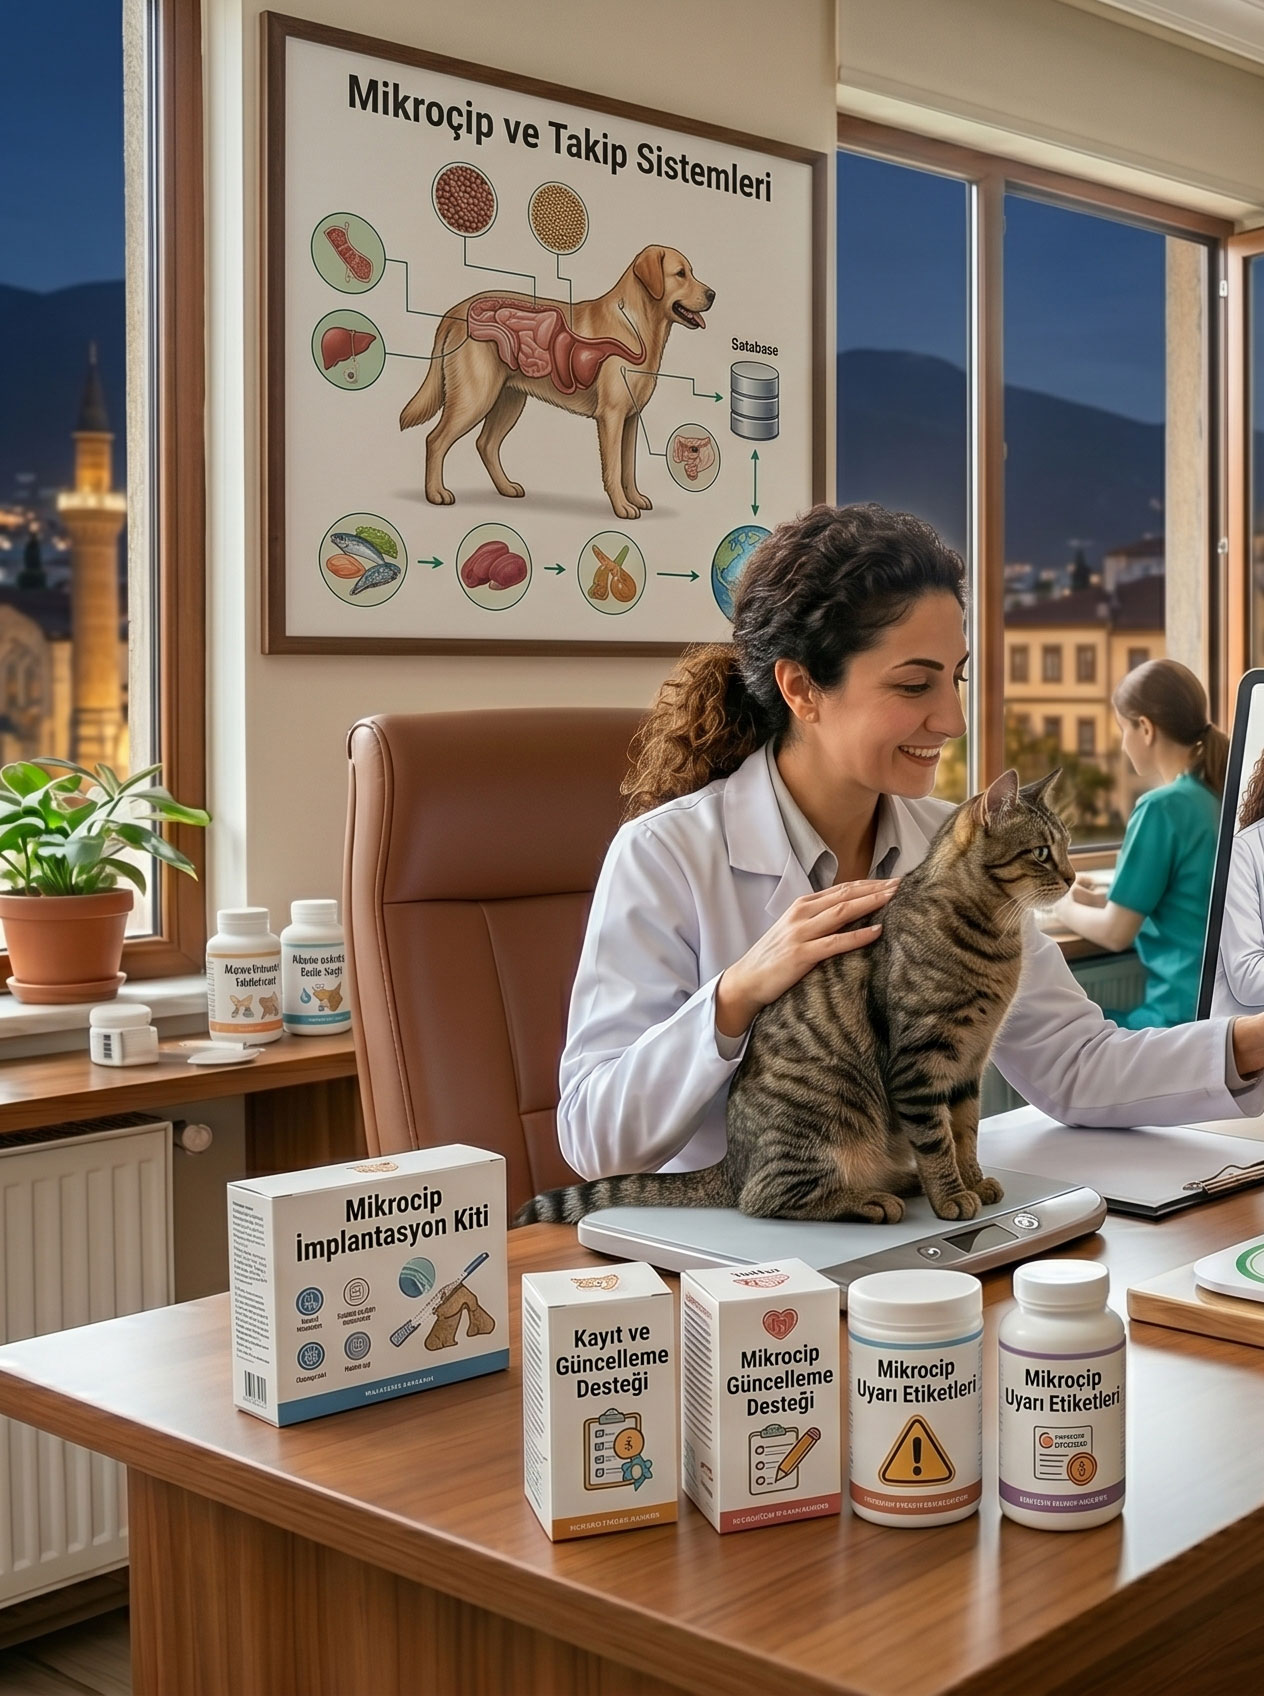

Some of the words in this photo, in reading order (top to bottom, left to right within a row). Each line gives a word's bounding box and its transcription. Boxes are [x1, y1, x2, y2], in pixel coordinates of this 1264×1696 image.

[348, 73, 494, 146] Mikroçip
[503, 116, 540, 149] ve
[548, 120, 628, 175] Takip
[636, 142, 773, 202] Sistemleri
[731, 337, 779, 356] Satabase
[345, 1185, 442, 1223] Mikrocip
[296, 1217, 447, 1262] İmplantasyon
[454, 1204, 490, 1233] Kiti
[574, 1325, 623, 1350] Kayıt
[628, 1325, 650, 1342] ve
[556, 1348, 669, 1376] Güncelleme
[740, 1344, 819, 1369] Mikrocip
[877, 1358, 955, 1379] Mikrocip
[727, 1368, 833, 1395] Güncelleme
[857, 1378, 898, 1404] Uyarı
[903, 1374, 977, 1403] Etiketleri
[1005, 1387, 1044, 1412] Uyarı
[1049, 1386, 1120, 1413] Etiketleri
